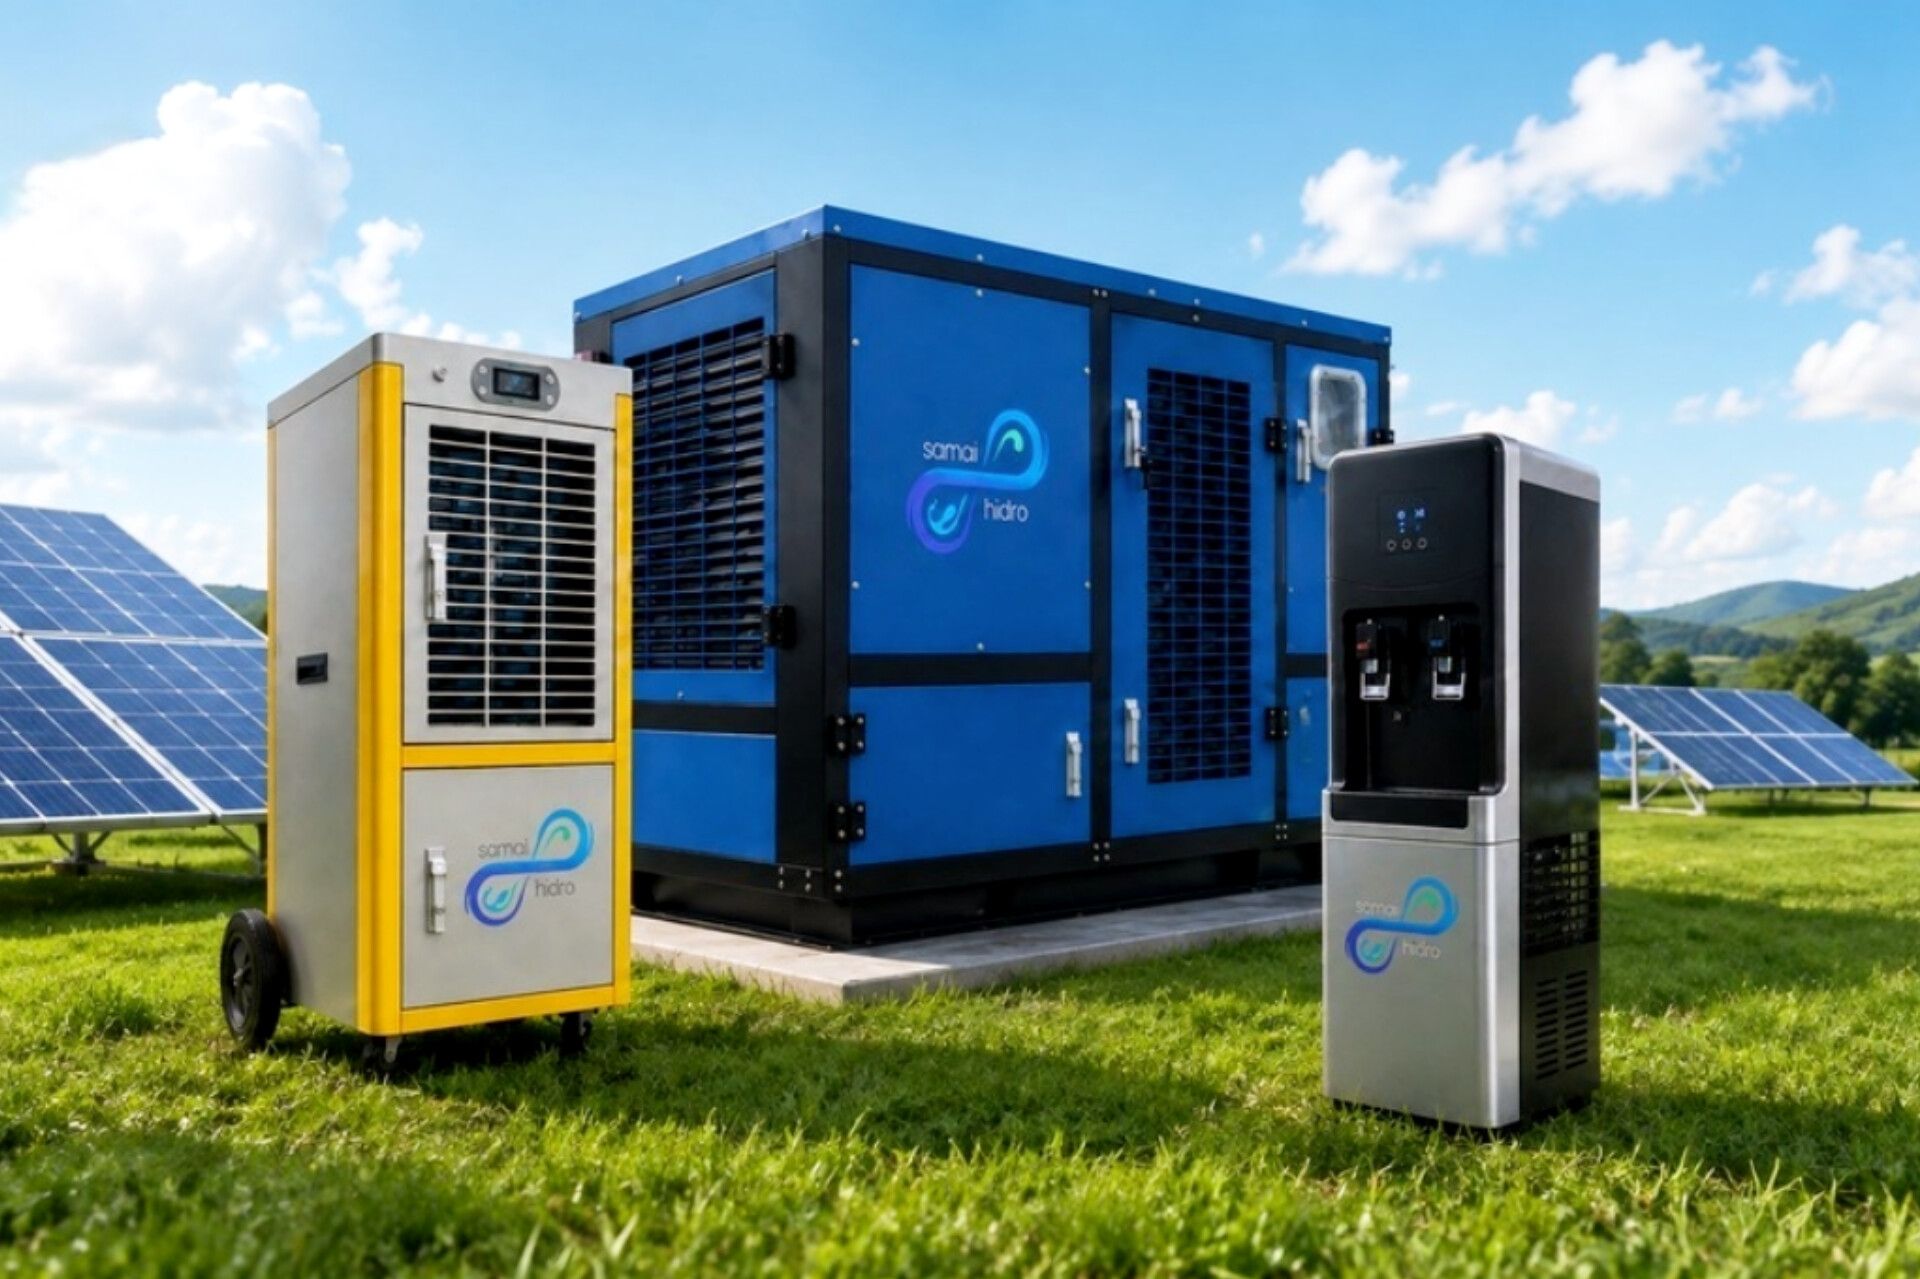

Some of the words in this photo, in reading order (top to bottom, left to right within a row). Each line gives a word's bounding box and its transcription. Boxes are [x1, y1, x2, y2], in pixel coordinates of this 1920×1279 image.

[922, 440, 978, 463] samai
[983, 498, 1029, 522] hidro
[478, 838, 529, 859] samai
[534, 878, 576, 897] hidro
